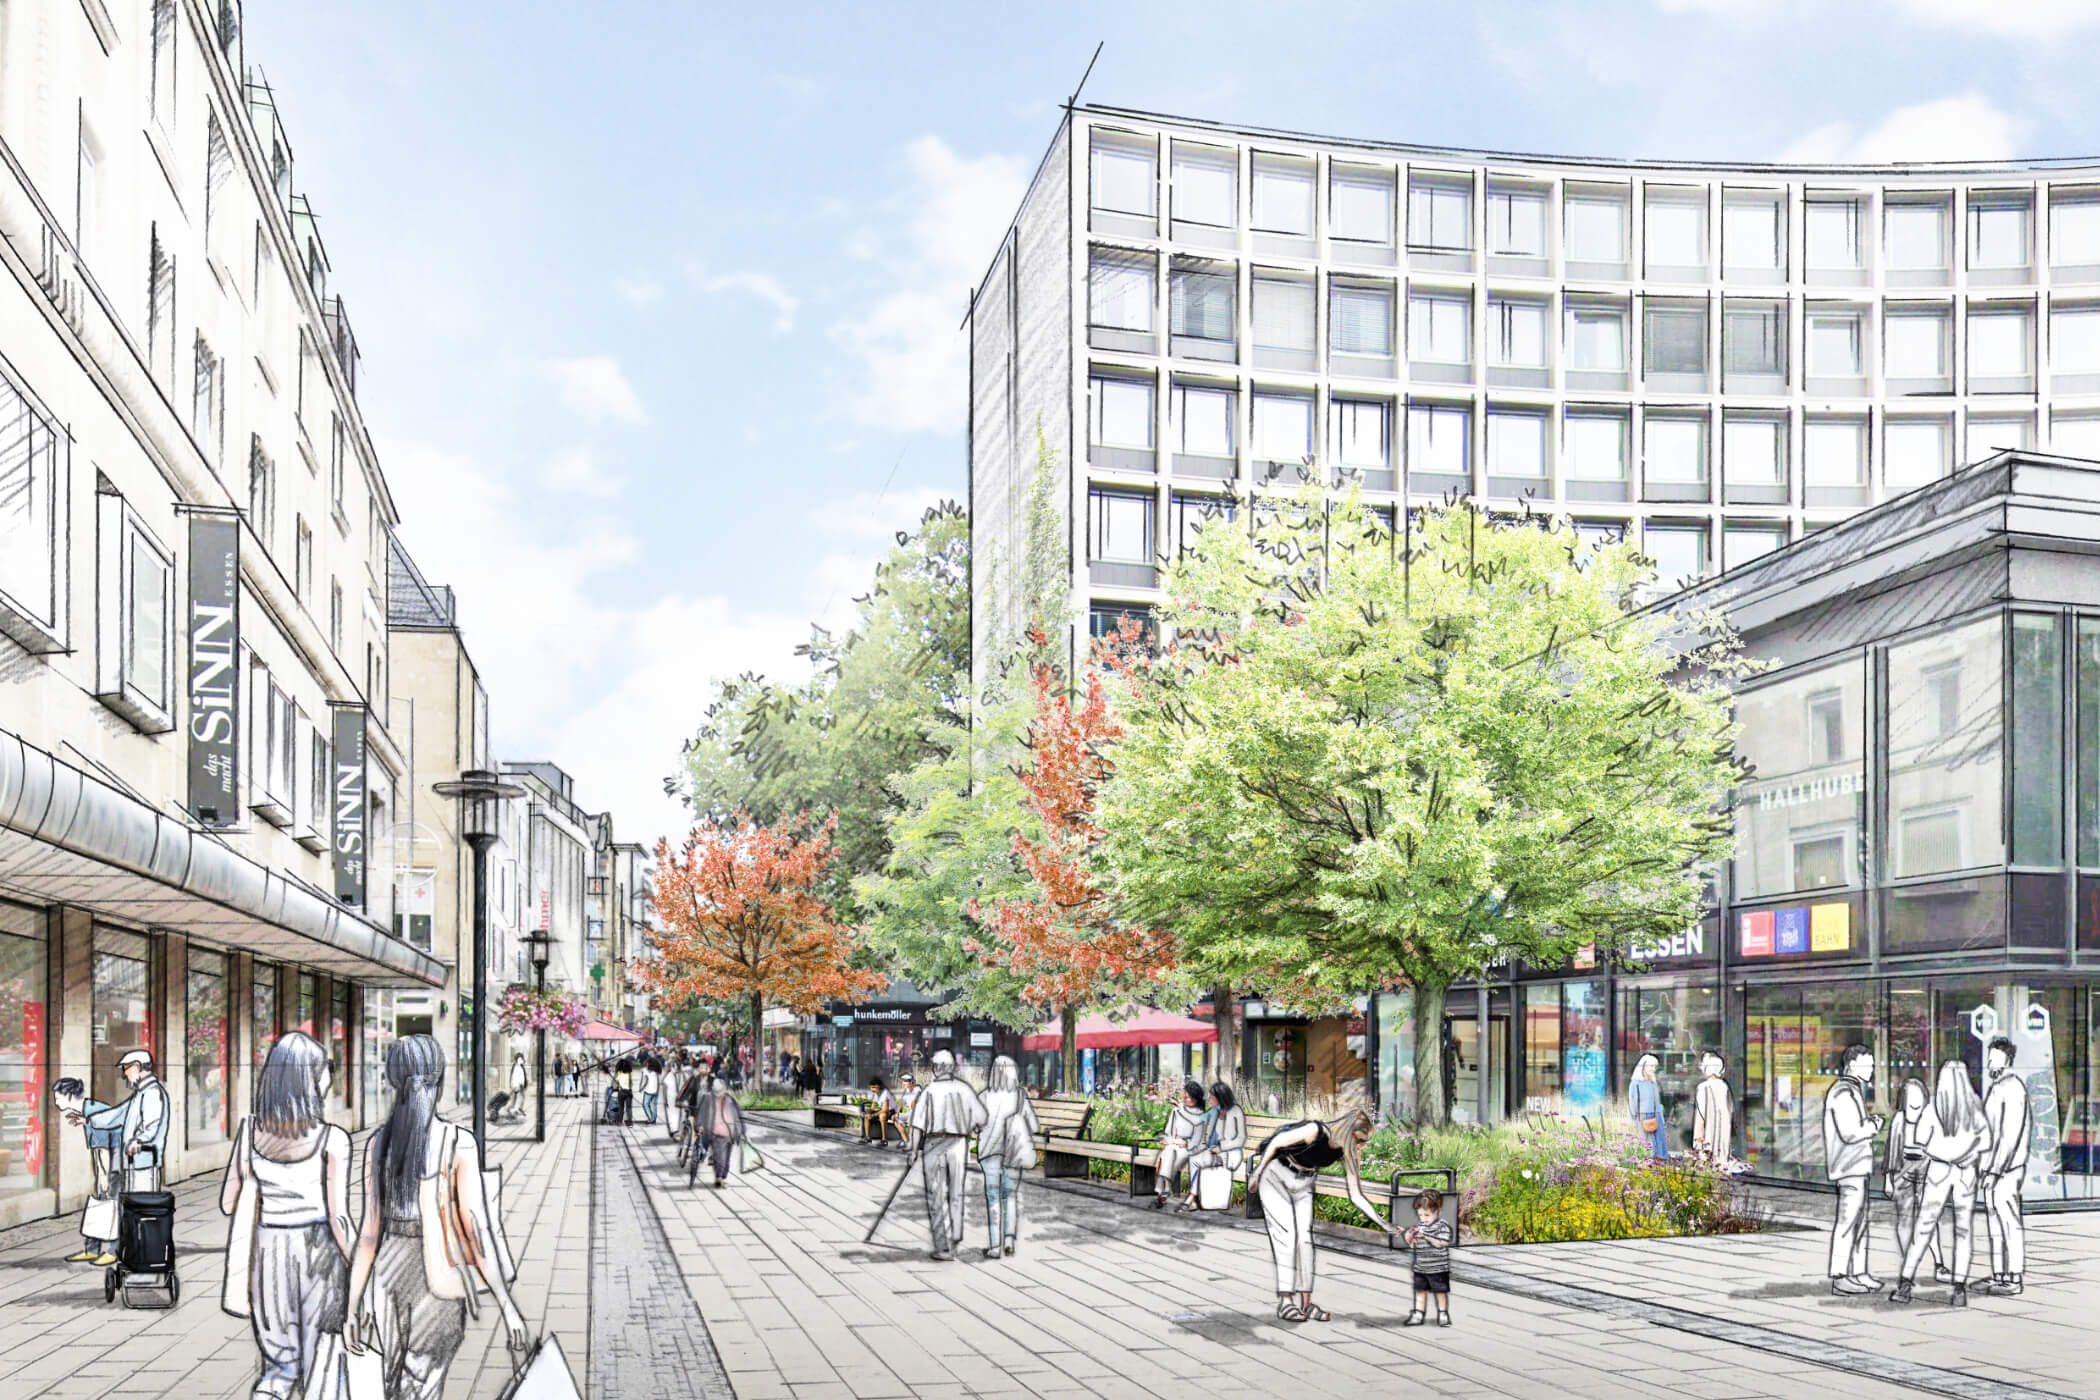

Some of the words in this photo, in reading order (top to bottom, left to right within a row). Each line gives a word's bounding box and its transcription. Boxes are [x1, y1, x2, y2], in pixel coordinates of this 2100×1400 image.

[224, 552, 233, 597] ESSEN
[203, 753, 217, 777] das
[215, 755, 232, 793] macht
[1631, 925, 1703, 959] ESSEN
